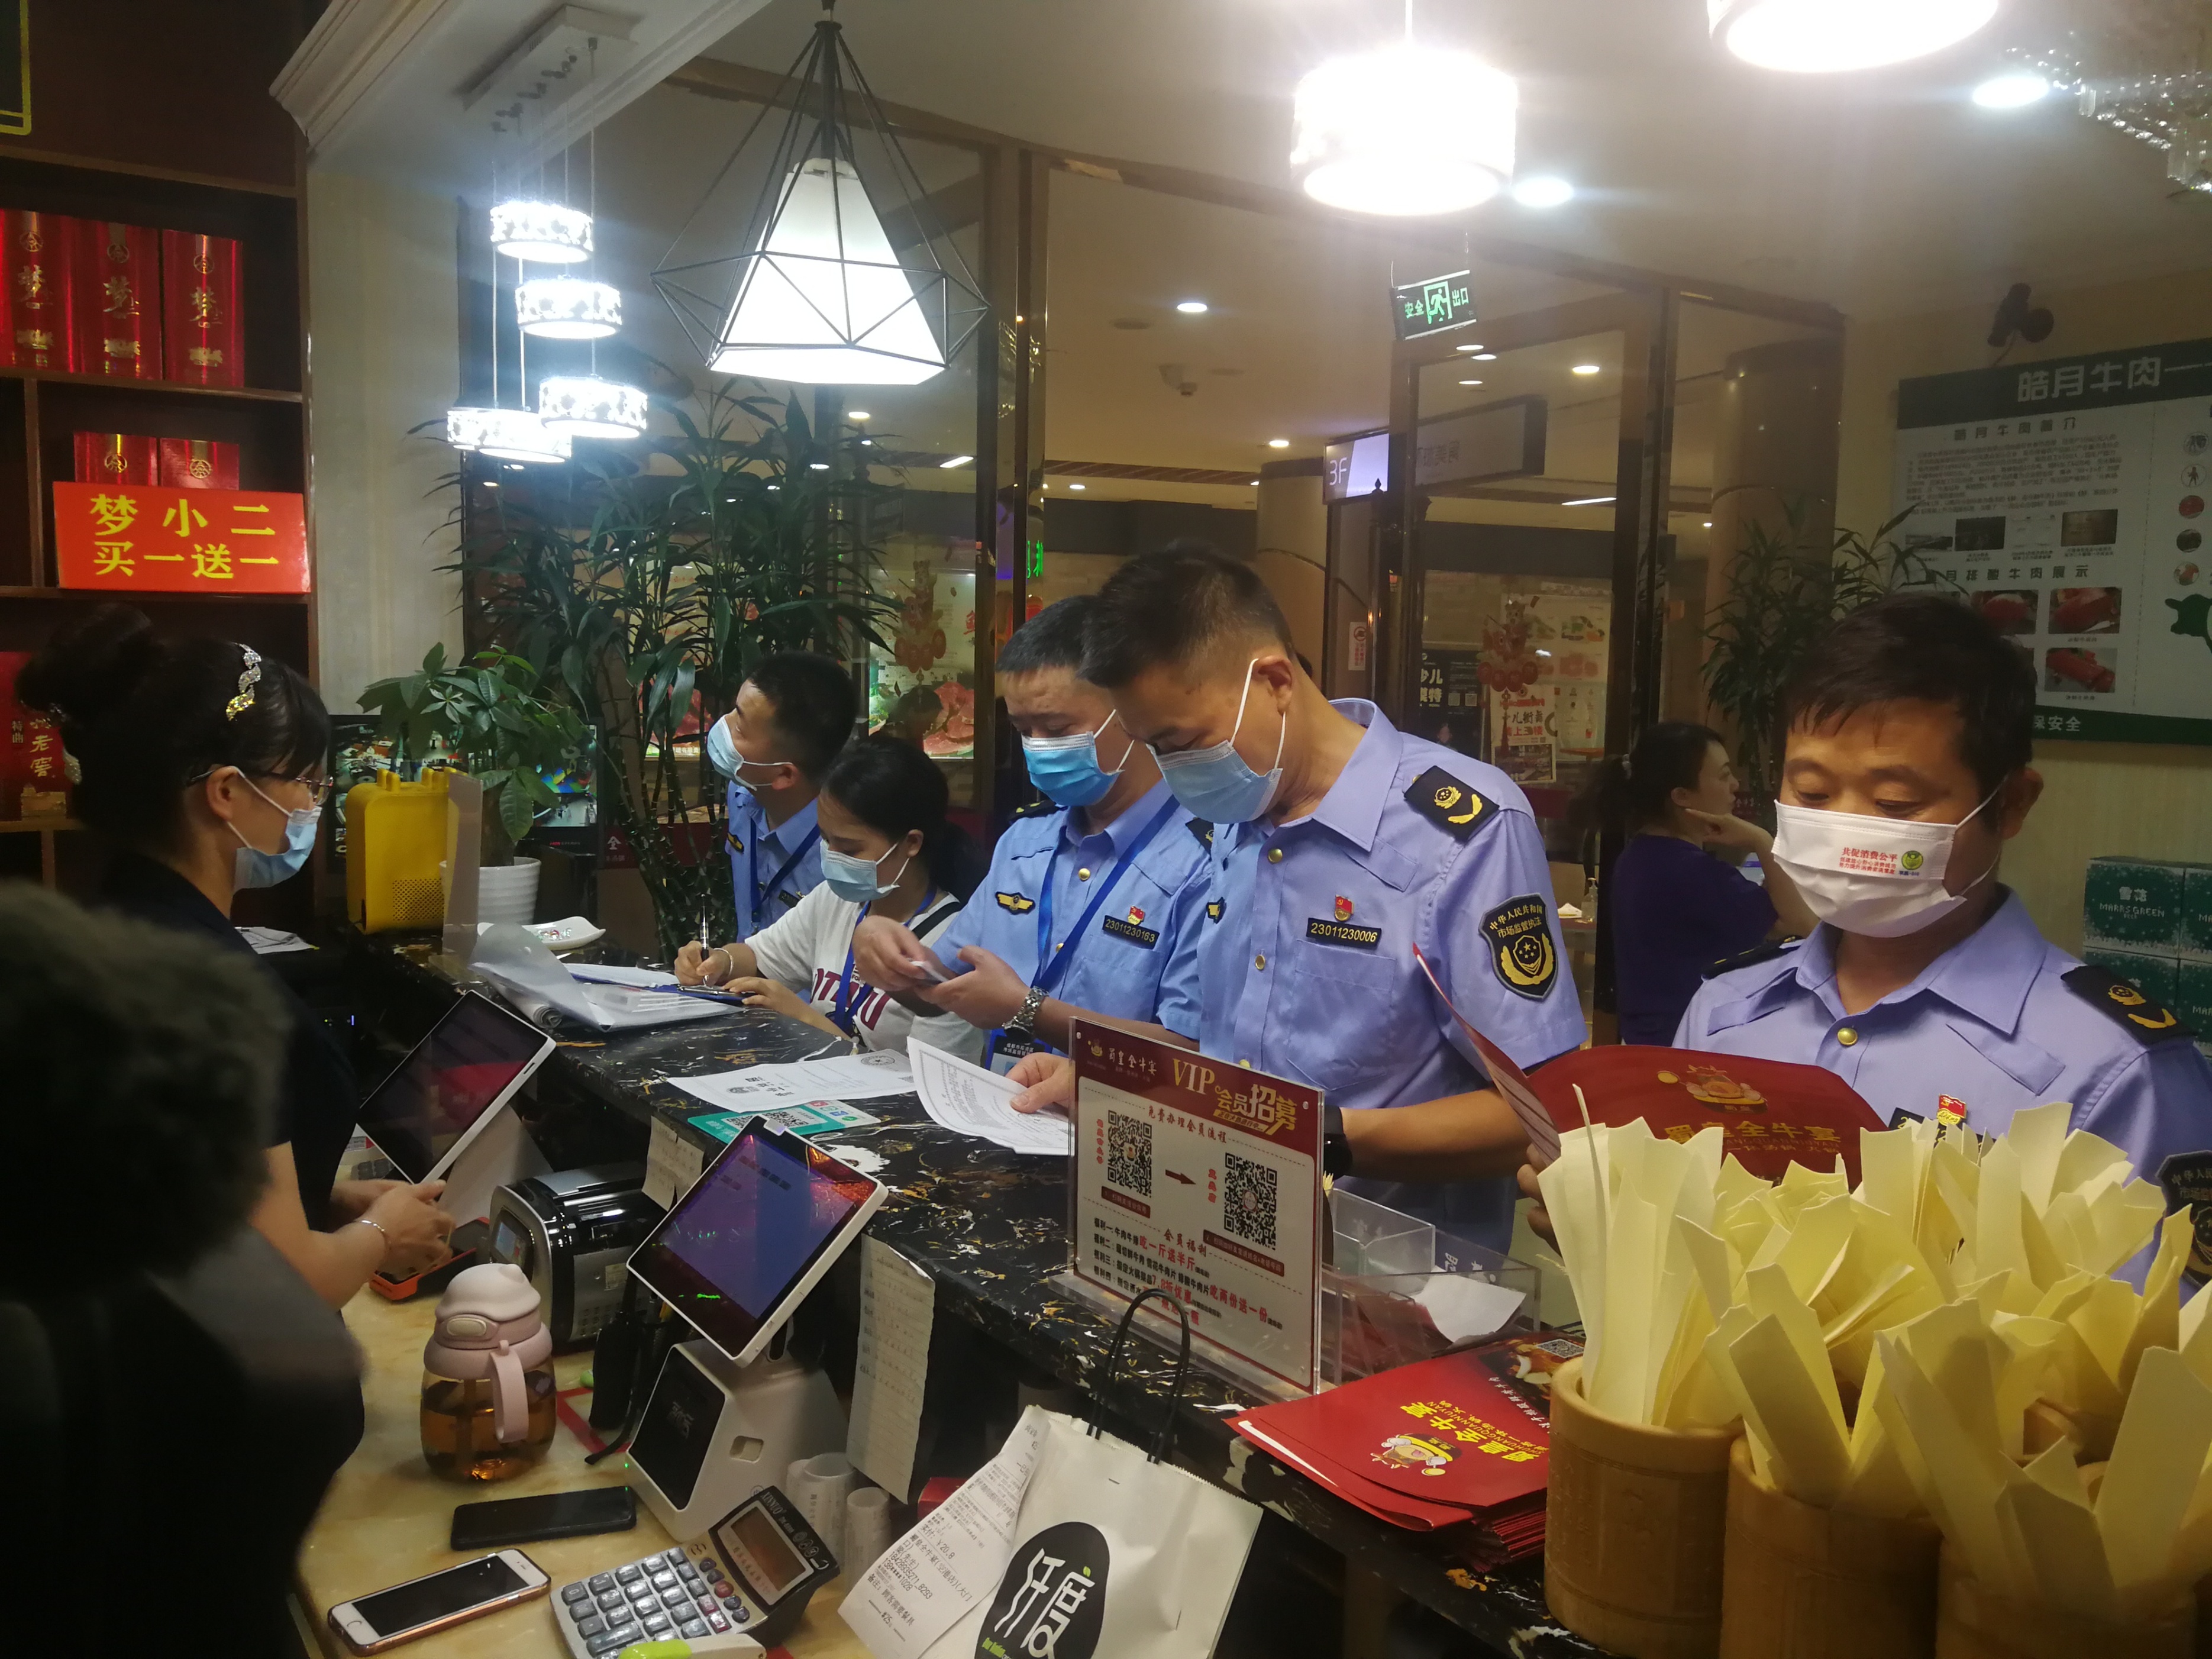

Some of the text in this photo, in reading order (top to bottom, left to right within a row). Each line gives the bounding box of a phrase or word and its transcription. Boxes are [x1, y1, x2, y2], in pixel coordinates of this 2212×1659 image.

[1404, 287, 1470, 319] 安全 出口
[1329, 457, 1348, 487] 3F
[90, 493, 276, 538] 梦小二
[93, 540, 280, 580] 买一送一
[1926, 564, 2089, 582] 月排酸牛肉展示
[1842, 847, 1898, 862] 共促消费公平
[1489, 903, 1543, 931] 中华人民共和国
[2132, 906, 2165, 918] GREEN
[1105, 918, 1155, 944] 23011230163
[1310, 922, 1378, 944] 23011230006
[1497, 916, 1542, 939] 市场监管执法
[1173, 1058, 1298, 1135] VIP 会员招募
